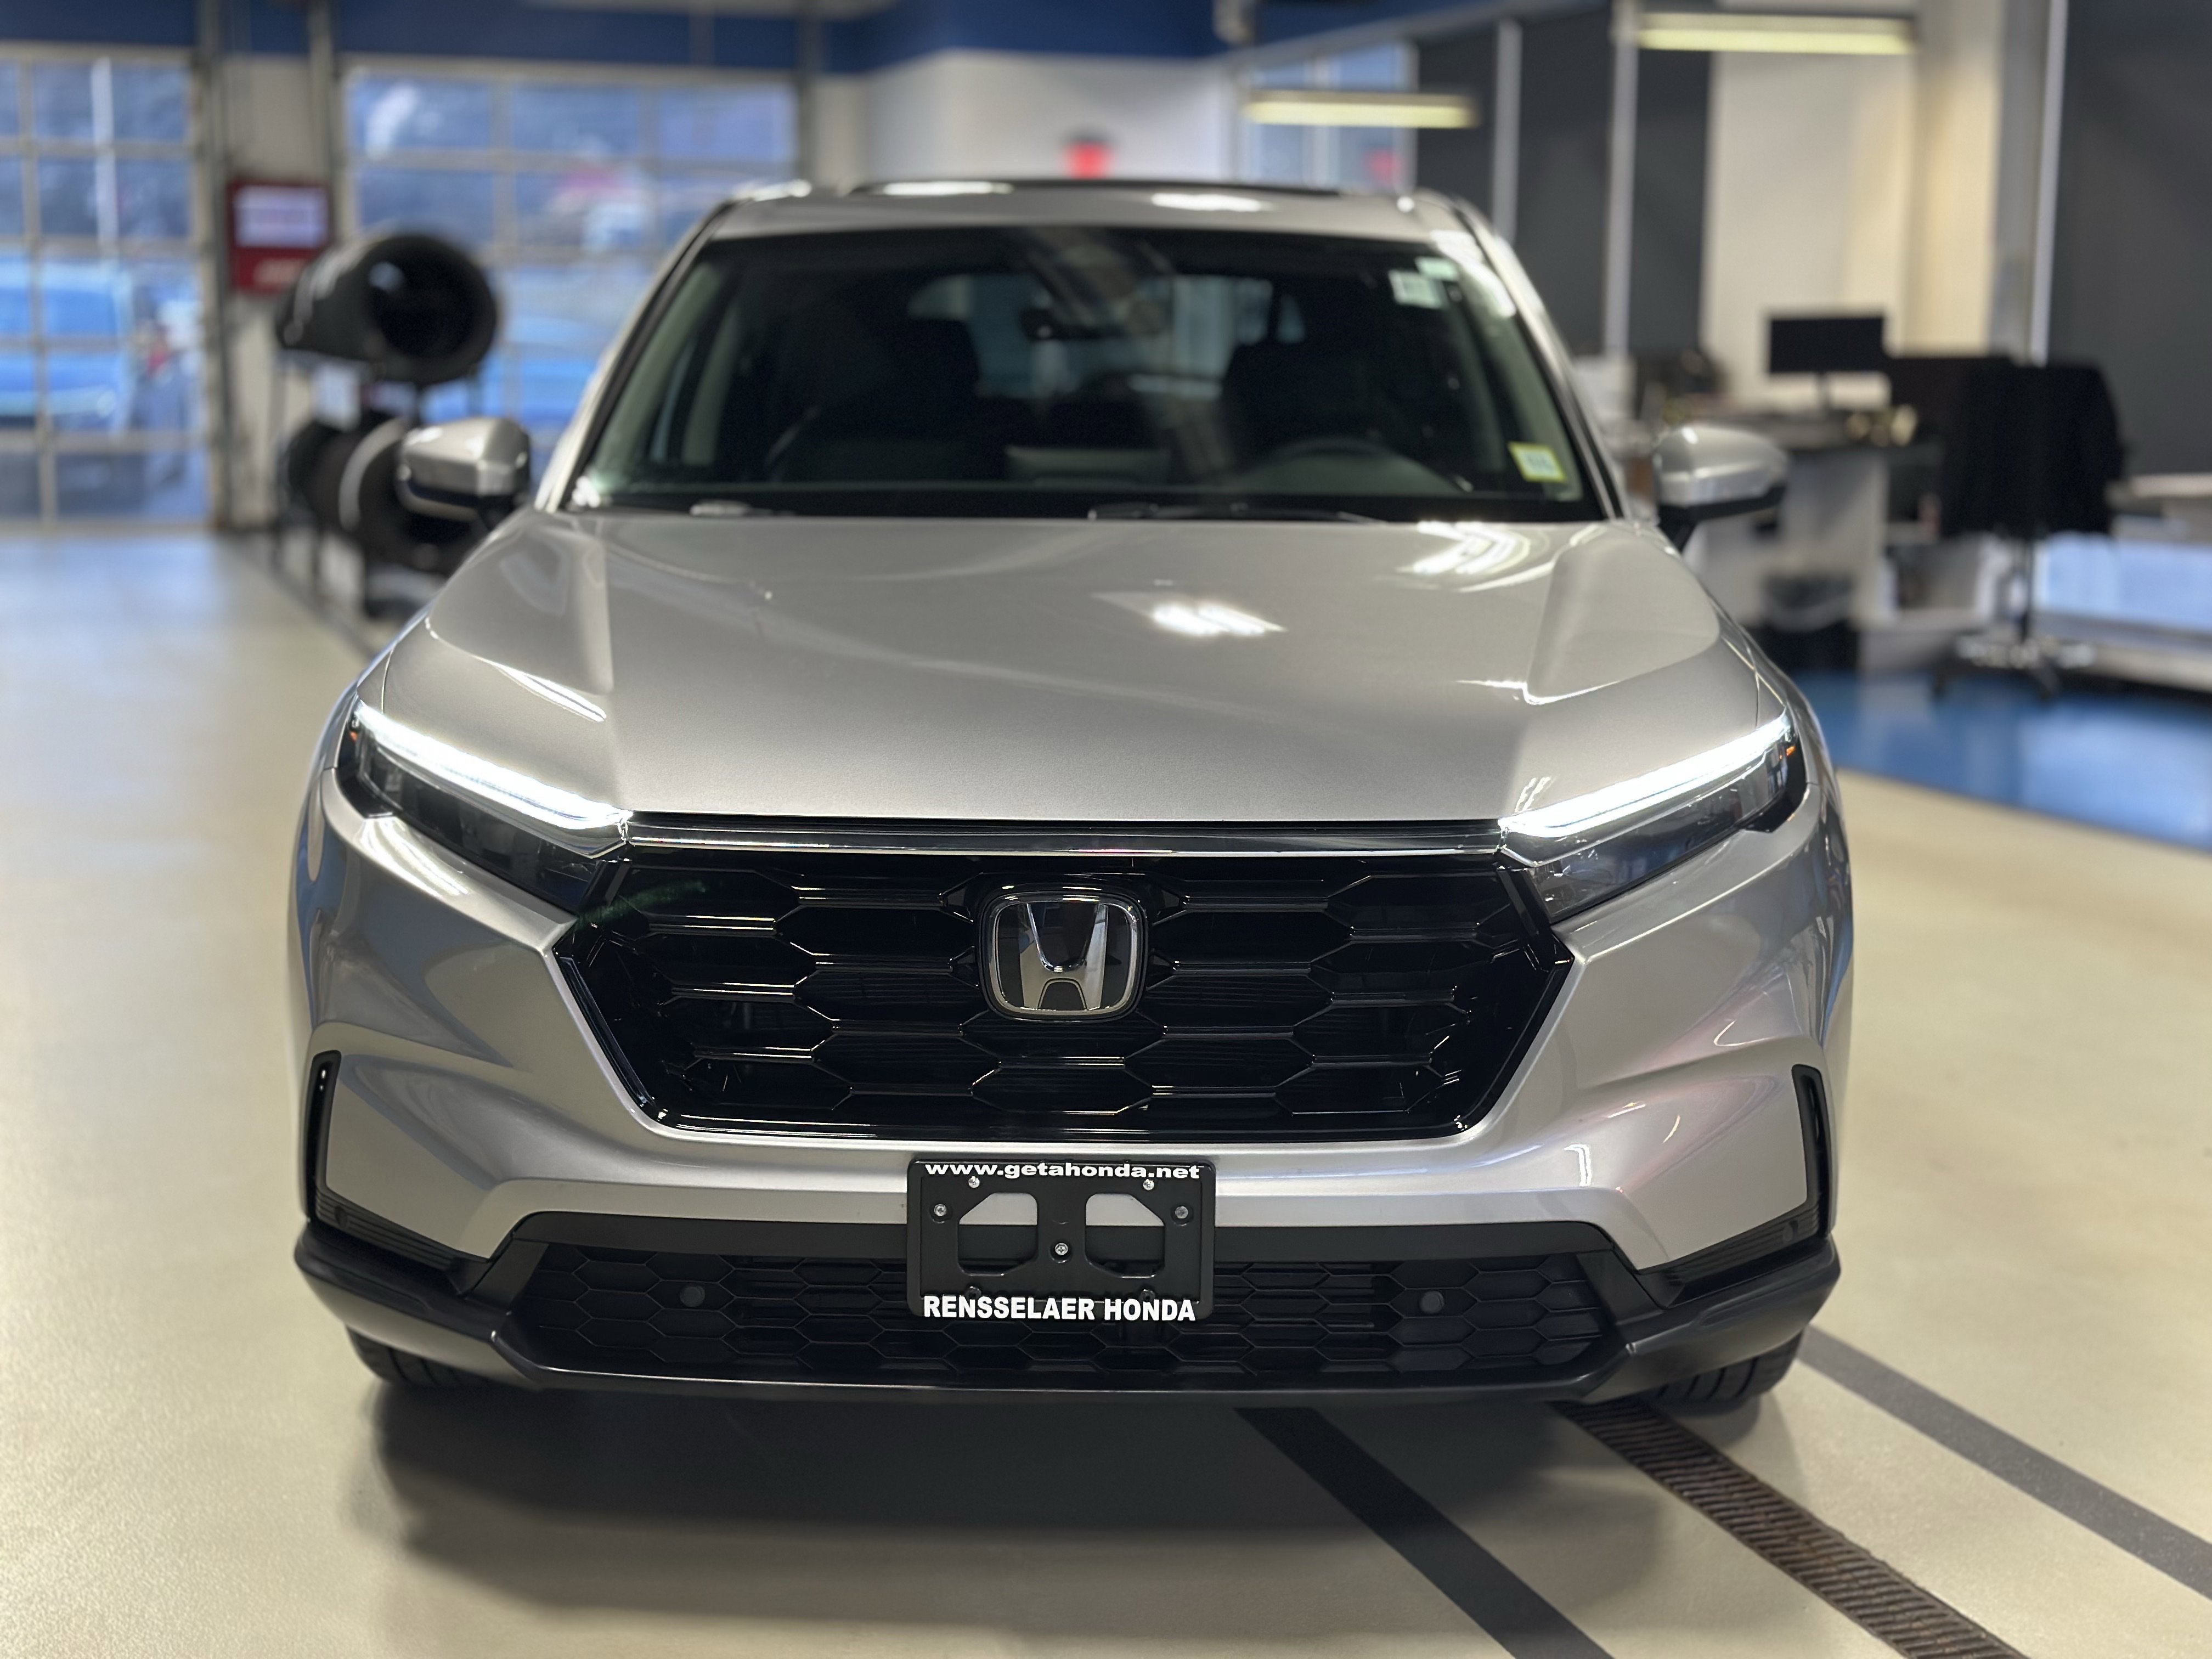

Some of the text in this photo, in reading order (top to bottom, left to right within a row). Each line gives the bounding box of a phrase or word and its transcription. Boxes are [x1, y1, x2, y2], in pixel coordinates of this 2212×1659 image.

[925, 1162, 1200, 1179] www.getahonda.net
[924, 1295, 1196, 1321] RENSSELAER HONDA
